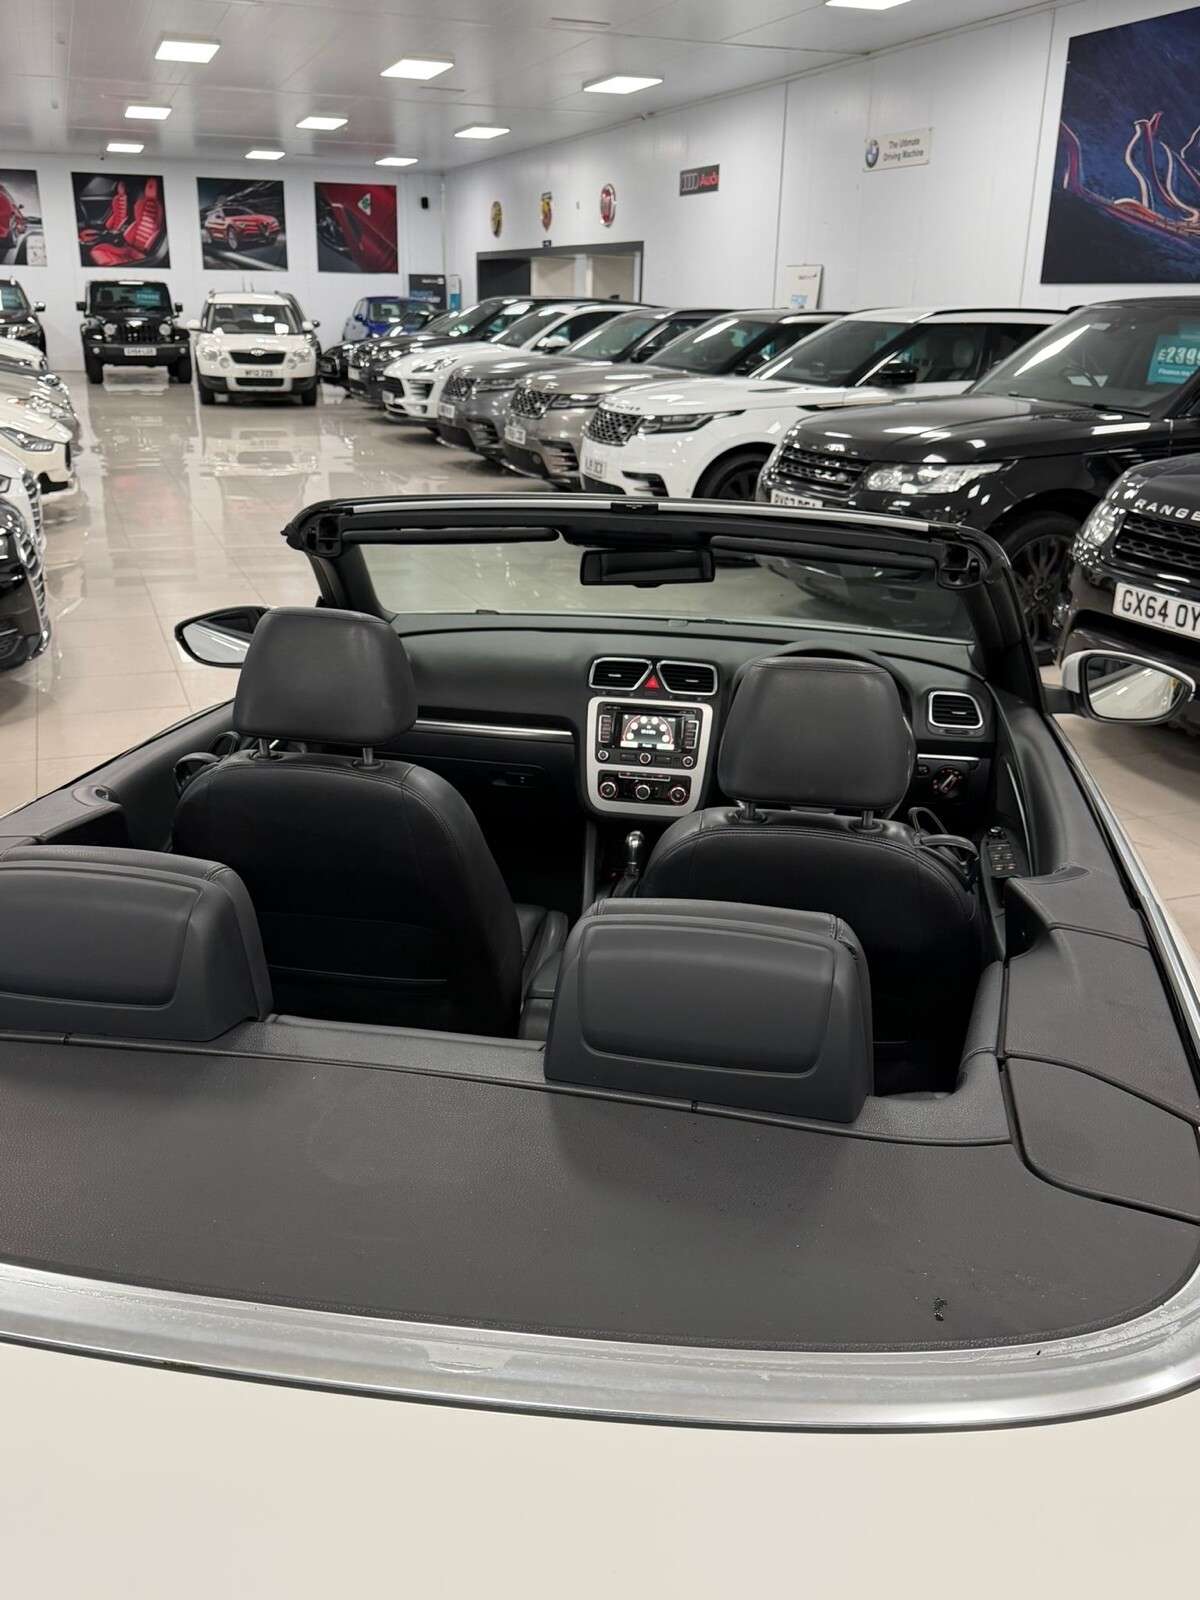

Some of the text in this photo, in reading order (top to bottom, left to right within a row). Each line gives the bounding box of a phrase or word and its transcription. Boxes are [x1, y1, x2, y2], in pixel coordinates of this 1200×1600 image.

[889, 140, 898, 149] The
[883, 149, 924, 162] Driving Machine
[1121, 589, 1169, 623] GX64
